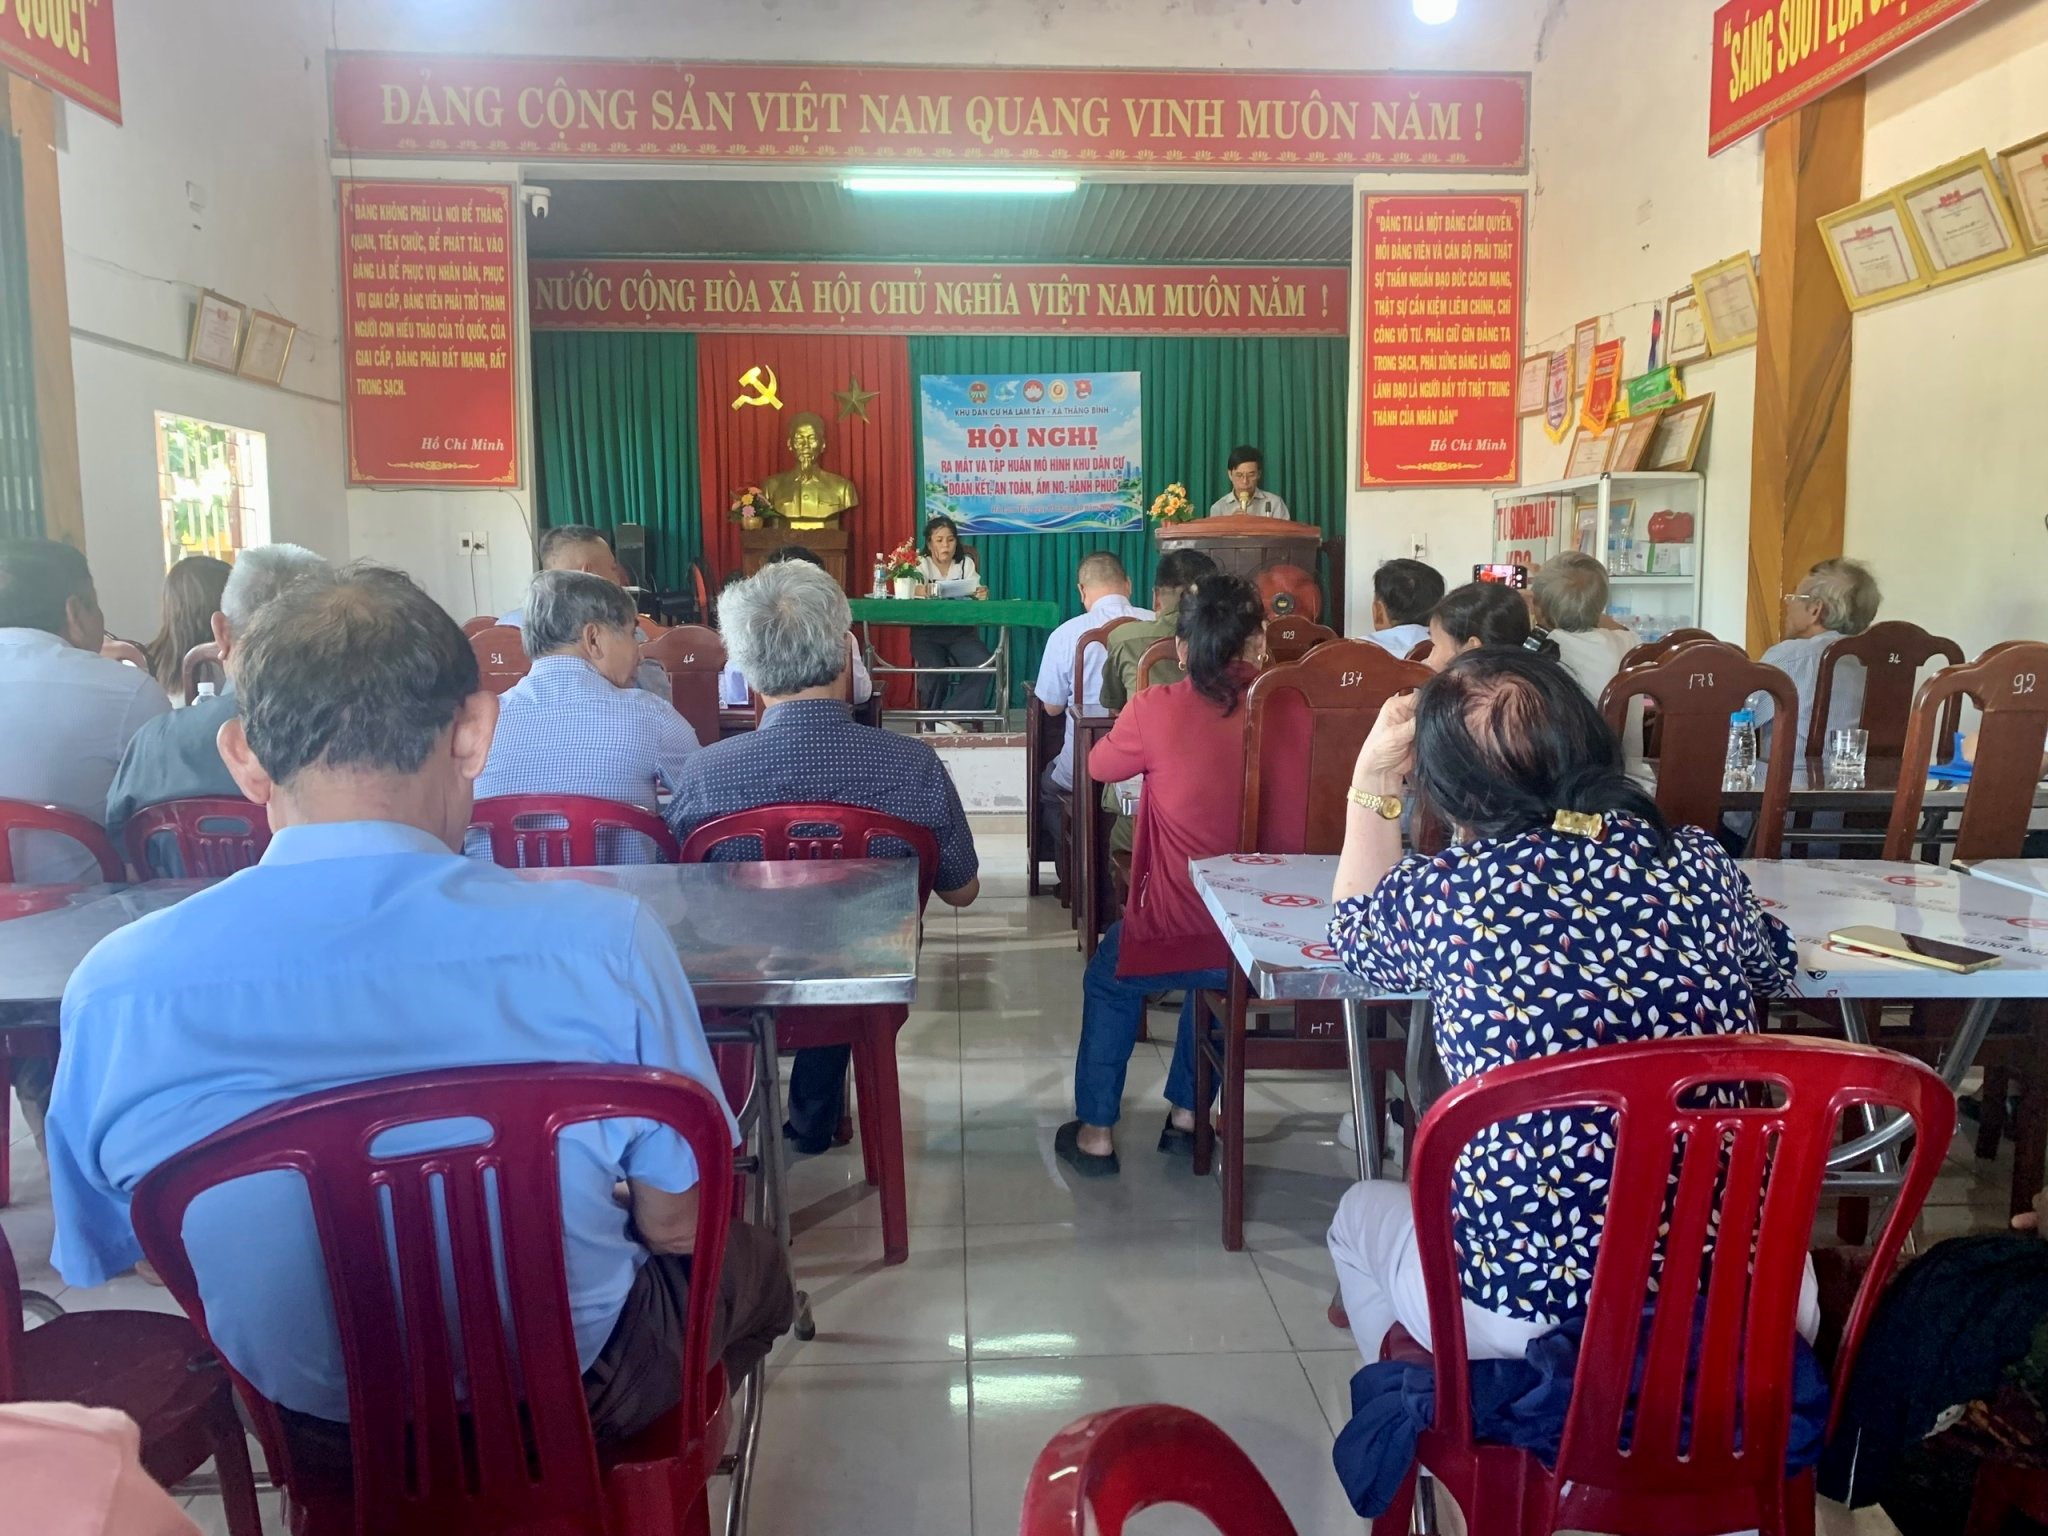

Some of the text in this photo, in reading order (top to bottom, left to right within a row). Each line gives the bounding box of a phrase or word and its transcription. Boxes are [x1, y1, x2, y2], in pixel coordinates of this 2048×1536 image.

[381, 67, 505, 128] ĐẢNG
[518, 76, 638, 140] CỘNG
[652, 73, 735, 131] SẢN
[747, 80, 847, 143] VIỆT
[859, 94, 952, 135] NAM
[965, 96, 1110, 145] QUANG
[1122, 98, 1224, 138] VINH
[1237, 90, 1359, 140] MUÔN
[1371, 91, 1462, 141] NĂM
[534, 268, 611, 312] NƯỚC
[620, 269, 696, 321] CỘNG
[704, 270, 760, 313] HÒA
[768, 272, 804, 314] XÃ
[812, 271, 861, 322] HỘI
[869, 267, 926, 315] CHỦ
[935, 273, 1020, 315] NGHĨA
[1028, 274, 1091, 325] VIỆT
[1097, 284, 1156, 316] NAM
[1163, 275, 1241, 317] MUÔN
[1248, 276, 1305, 317] NĂM
[422, 436, 504, 450] Hồ Chí Minh
[967, 424, 1098, 453] HỘI NGHỊ
[1429, 438, 1507, 451] Hồ Chí Minh
[1282, 631, 1294, 639] 109
[490, 653, 503, 664] 51
[1340, 671, 1363, 686] 137
[1689, 673, 1713, 689] 178
[2012, 673, 2036, 695] 92
